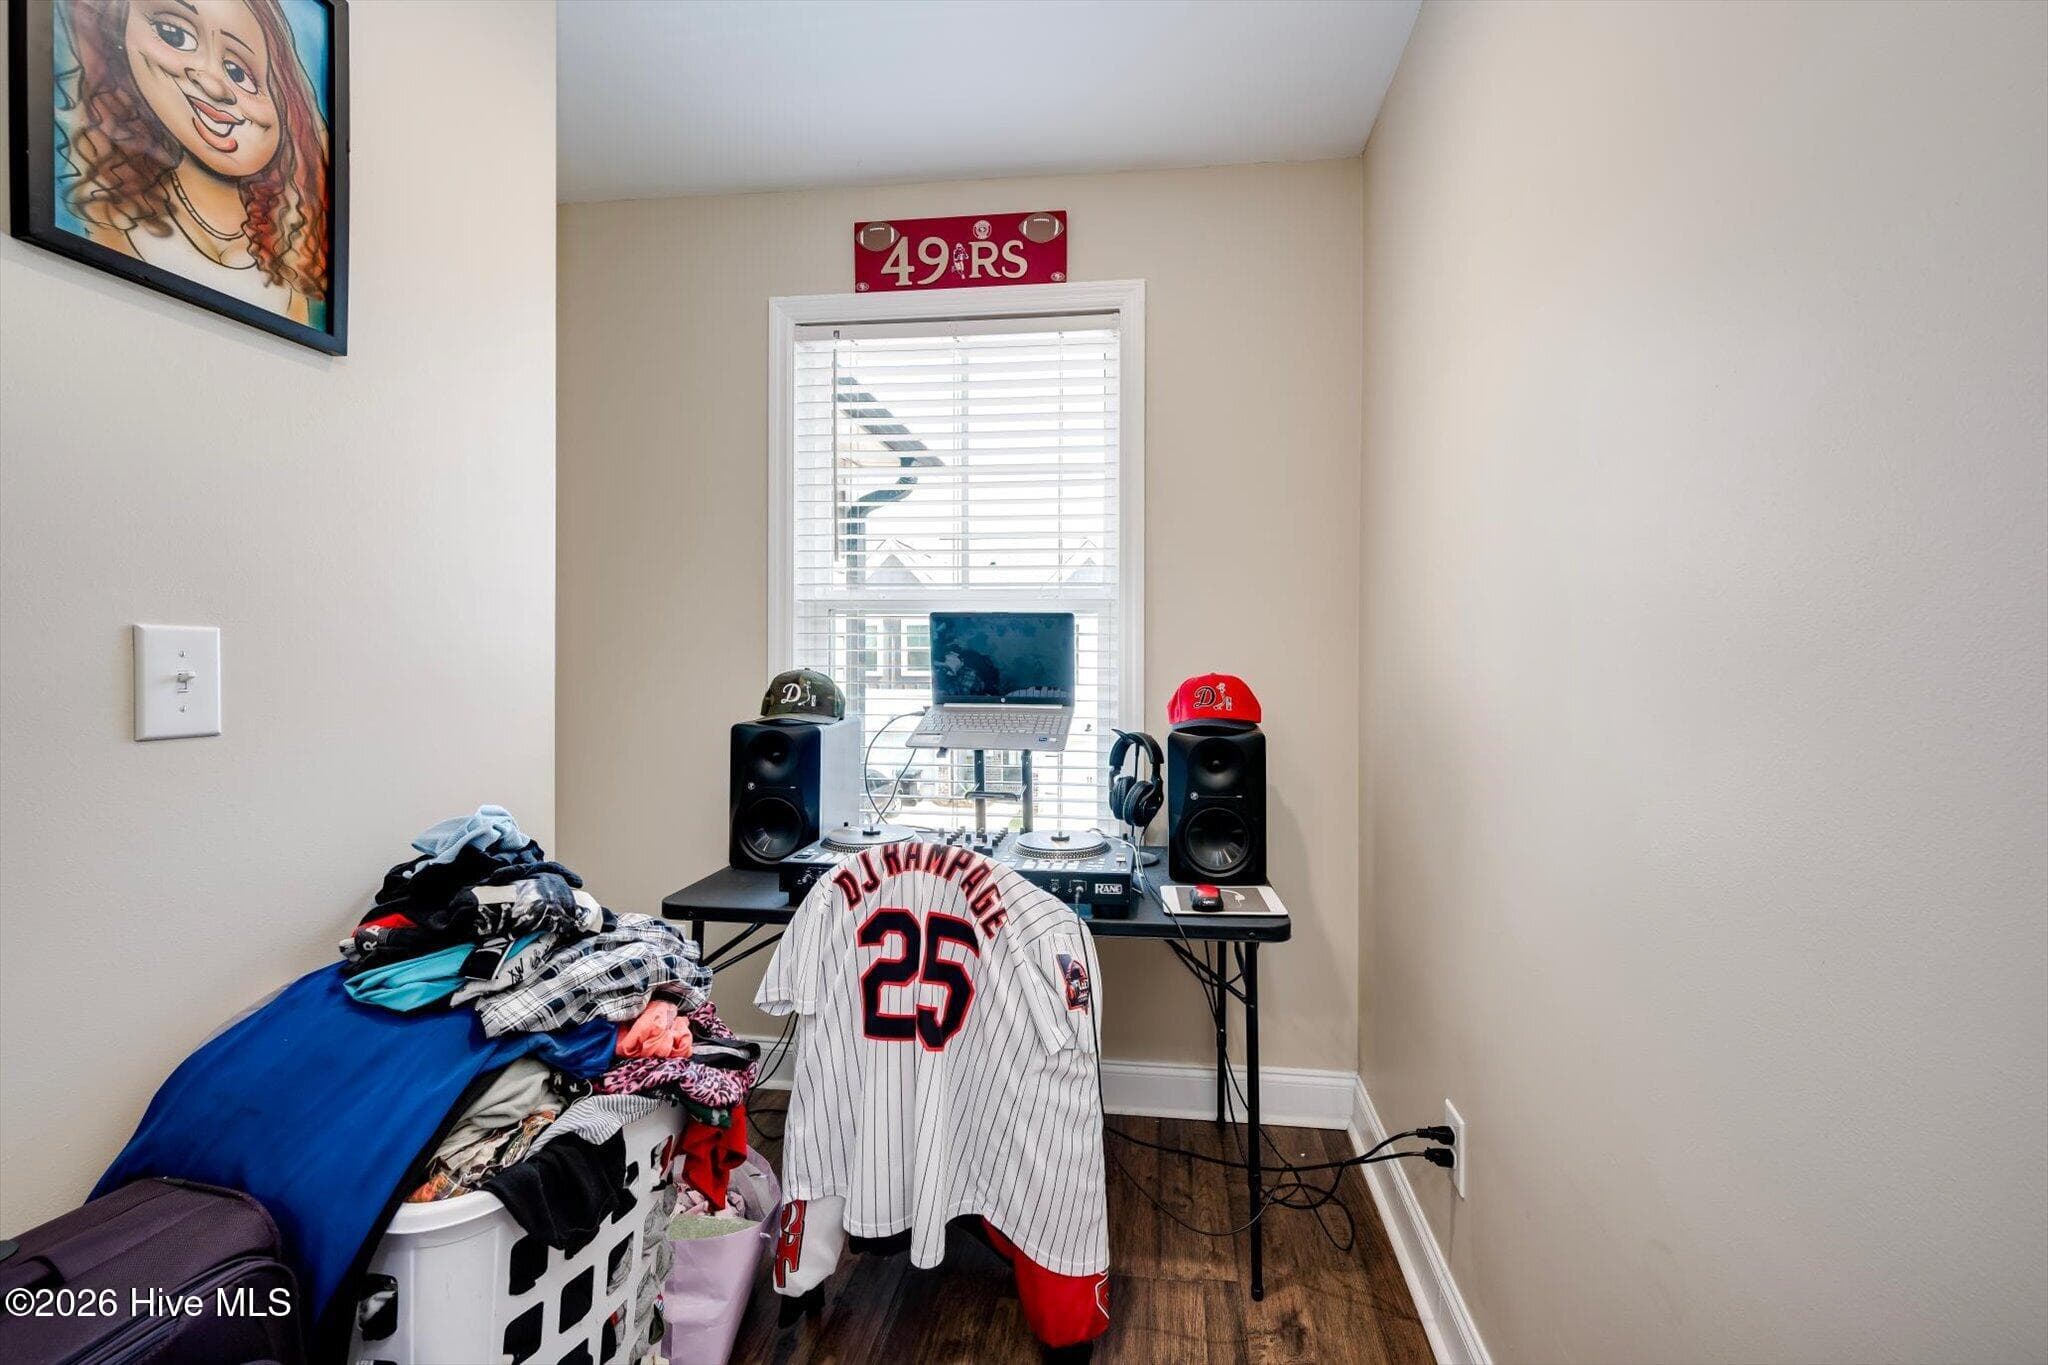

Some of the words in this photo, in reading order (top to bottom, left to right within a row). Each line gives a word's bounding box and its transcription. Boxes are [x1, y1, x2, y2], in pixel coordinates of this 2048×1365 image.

[833, 851, 880, 911] DJ
[881, 842, 1008, 940] RAMPAGE
[1095, 883, 1123, 895] RANE
[857, 907, 980, 1052] 25
